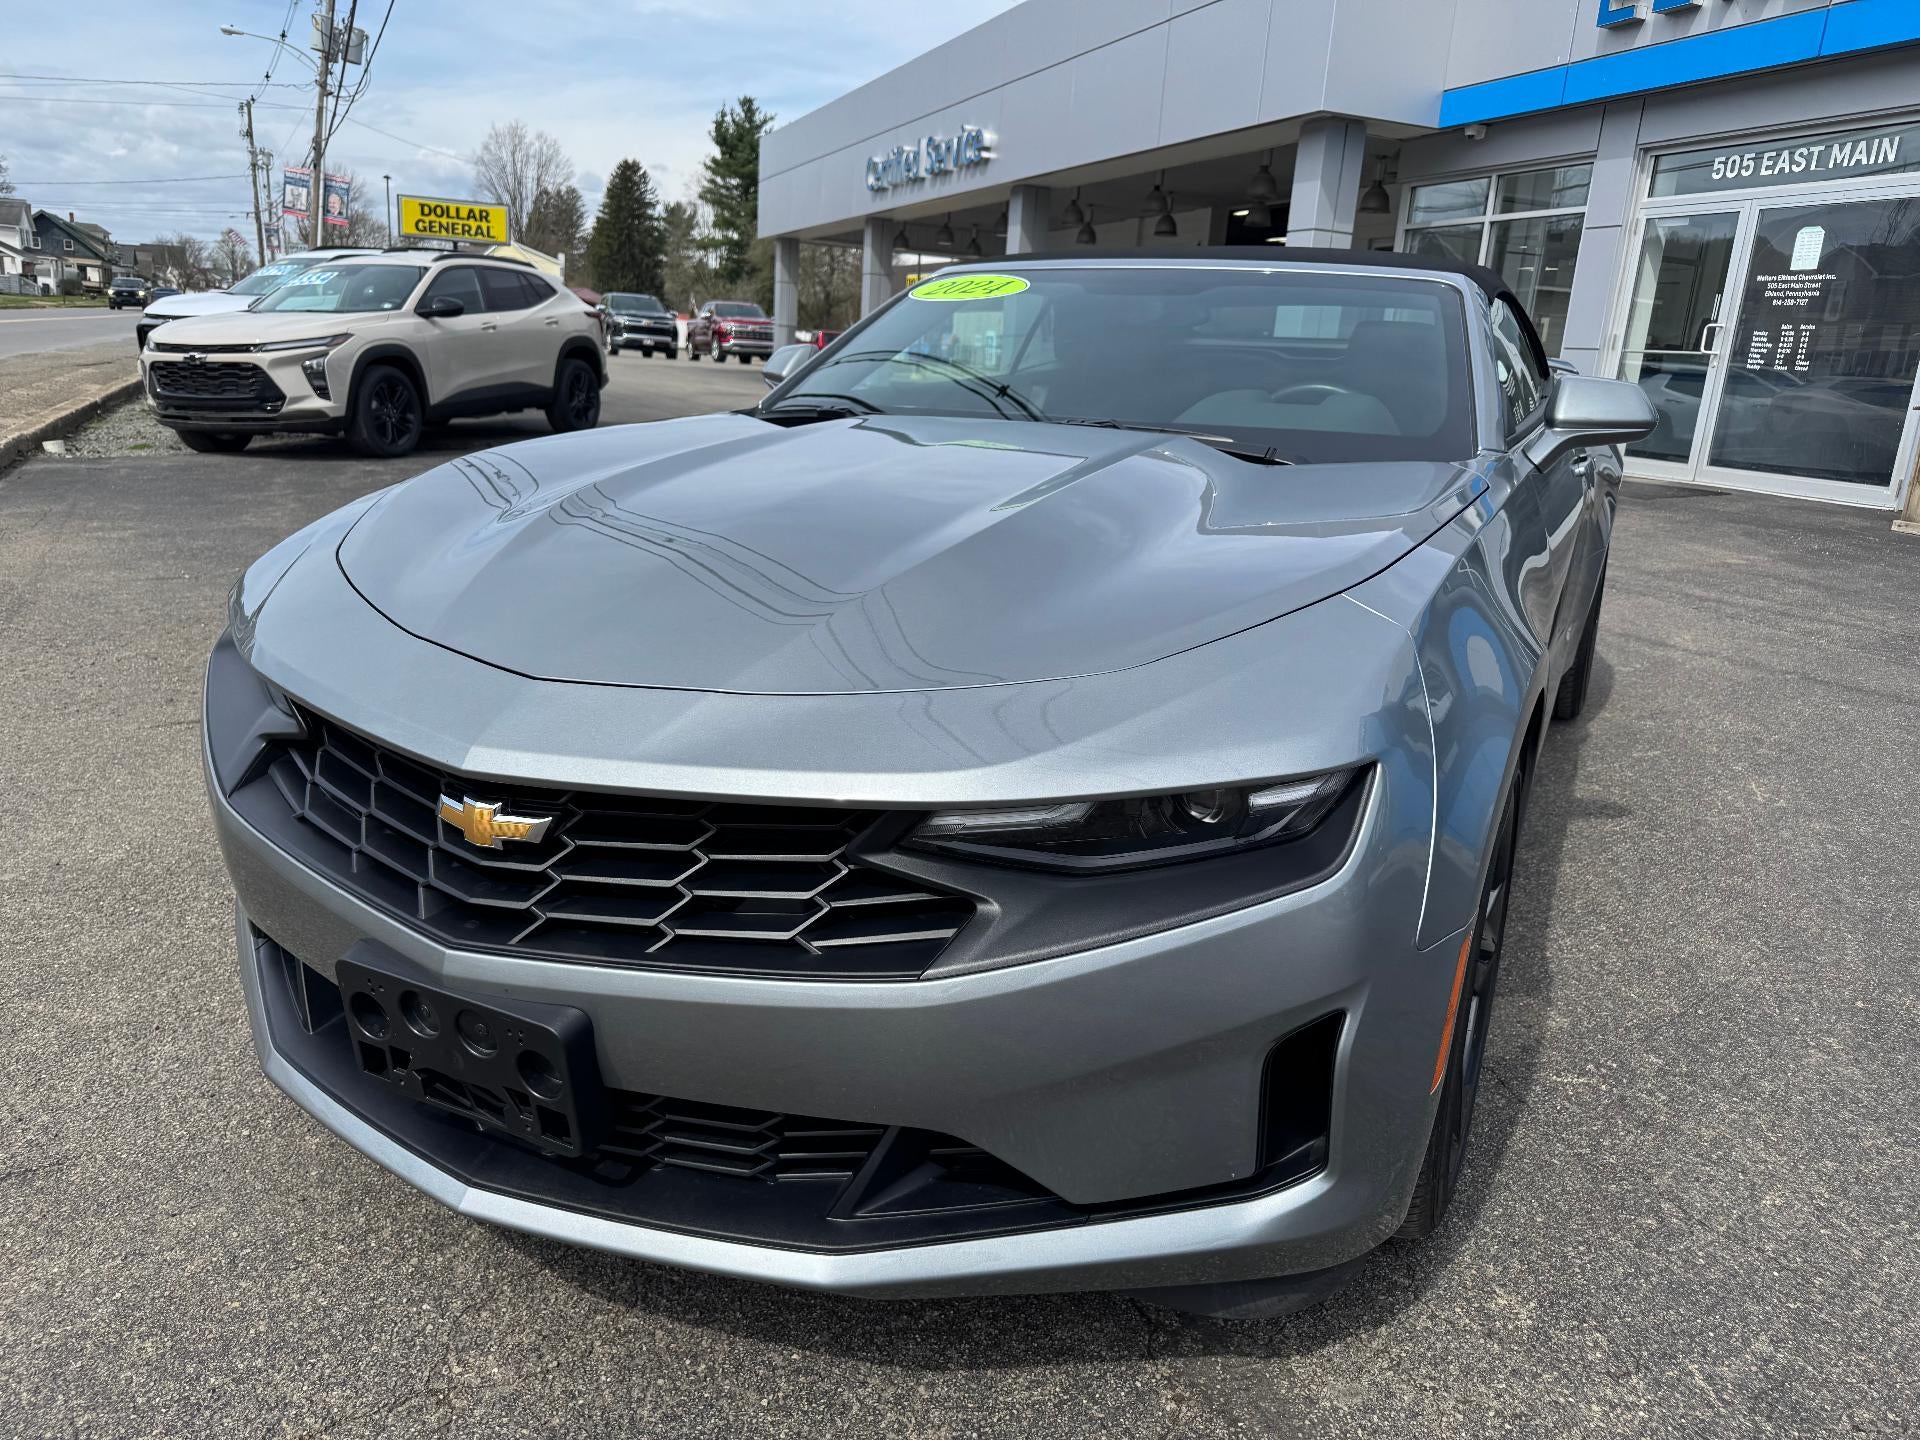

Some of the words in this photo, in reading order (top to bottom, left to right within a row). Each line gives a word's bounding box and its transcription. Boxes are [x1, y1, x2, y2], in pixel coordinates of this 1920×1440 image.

[925, 124, 988, 177] Service
[1711, 152, 1756, 180] 505
[1759, 145, 1825, 176] EAST
[1828, 135, 1901, 169] MAIN
[418, 203, 491, 223] DOLLAR
[414, 218, 496, 239] GENERAL
[923, 280, 1015, 296] 2024
[1786, 290, 1820, 298] Pennsylvania
